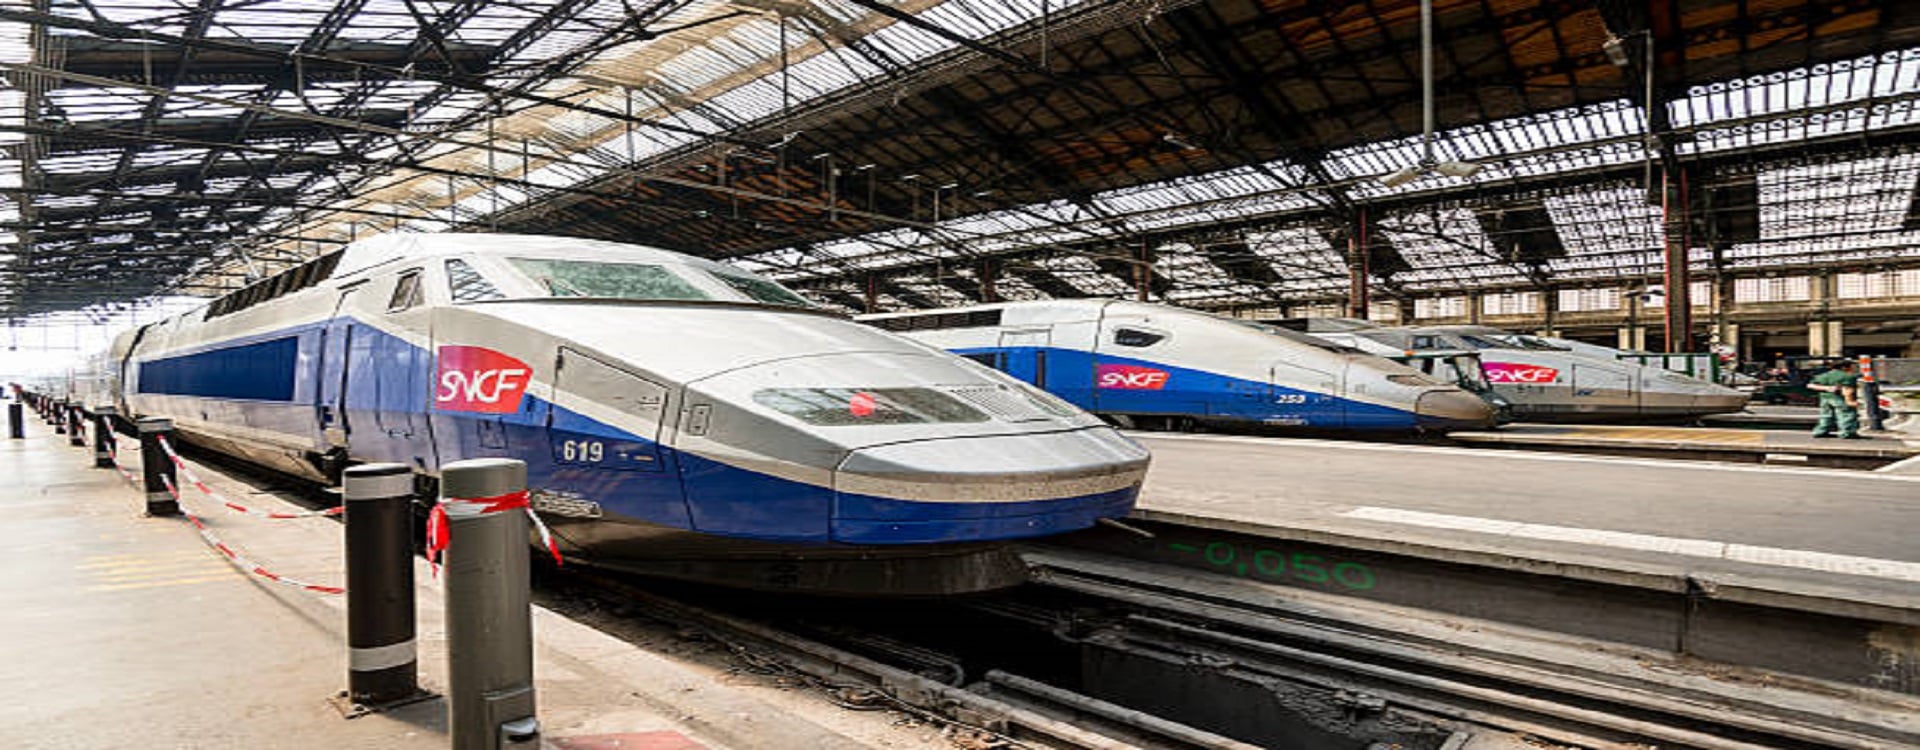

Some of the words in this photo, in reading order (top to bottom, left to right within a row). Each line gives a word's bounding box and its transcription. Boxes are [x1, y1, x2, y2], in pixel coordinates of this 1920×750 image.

[1100, 372, 1165, 387] SNCF
[1486, 368, 1553, 382] SNCF
[437, 368, 525, 403] SNCF
[563, 440, 604, 462] 619
